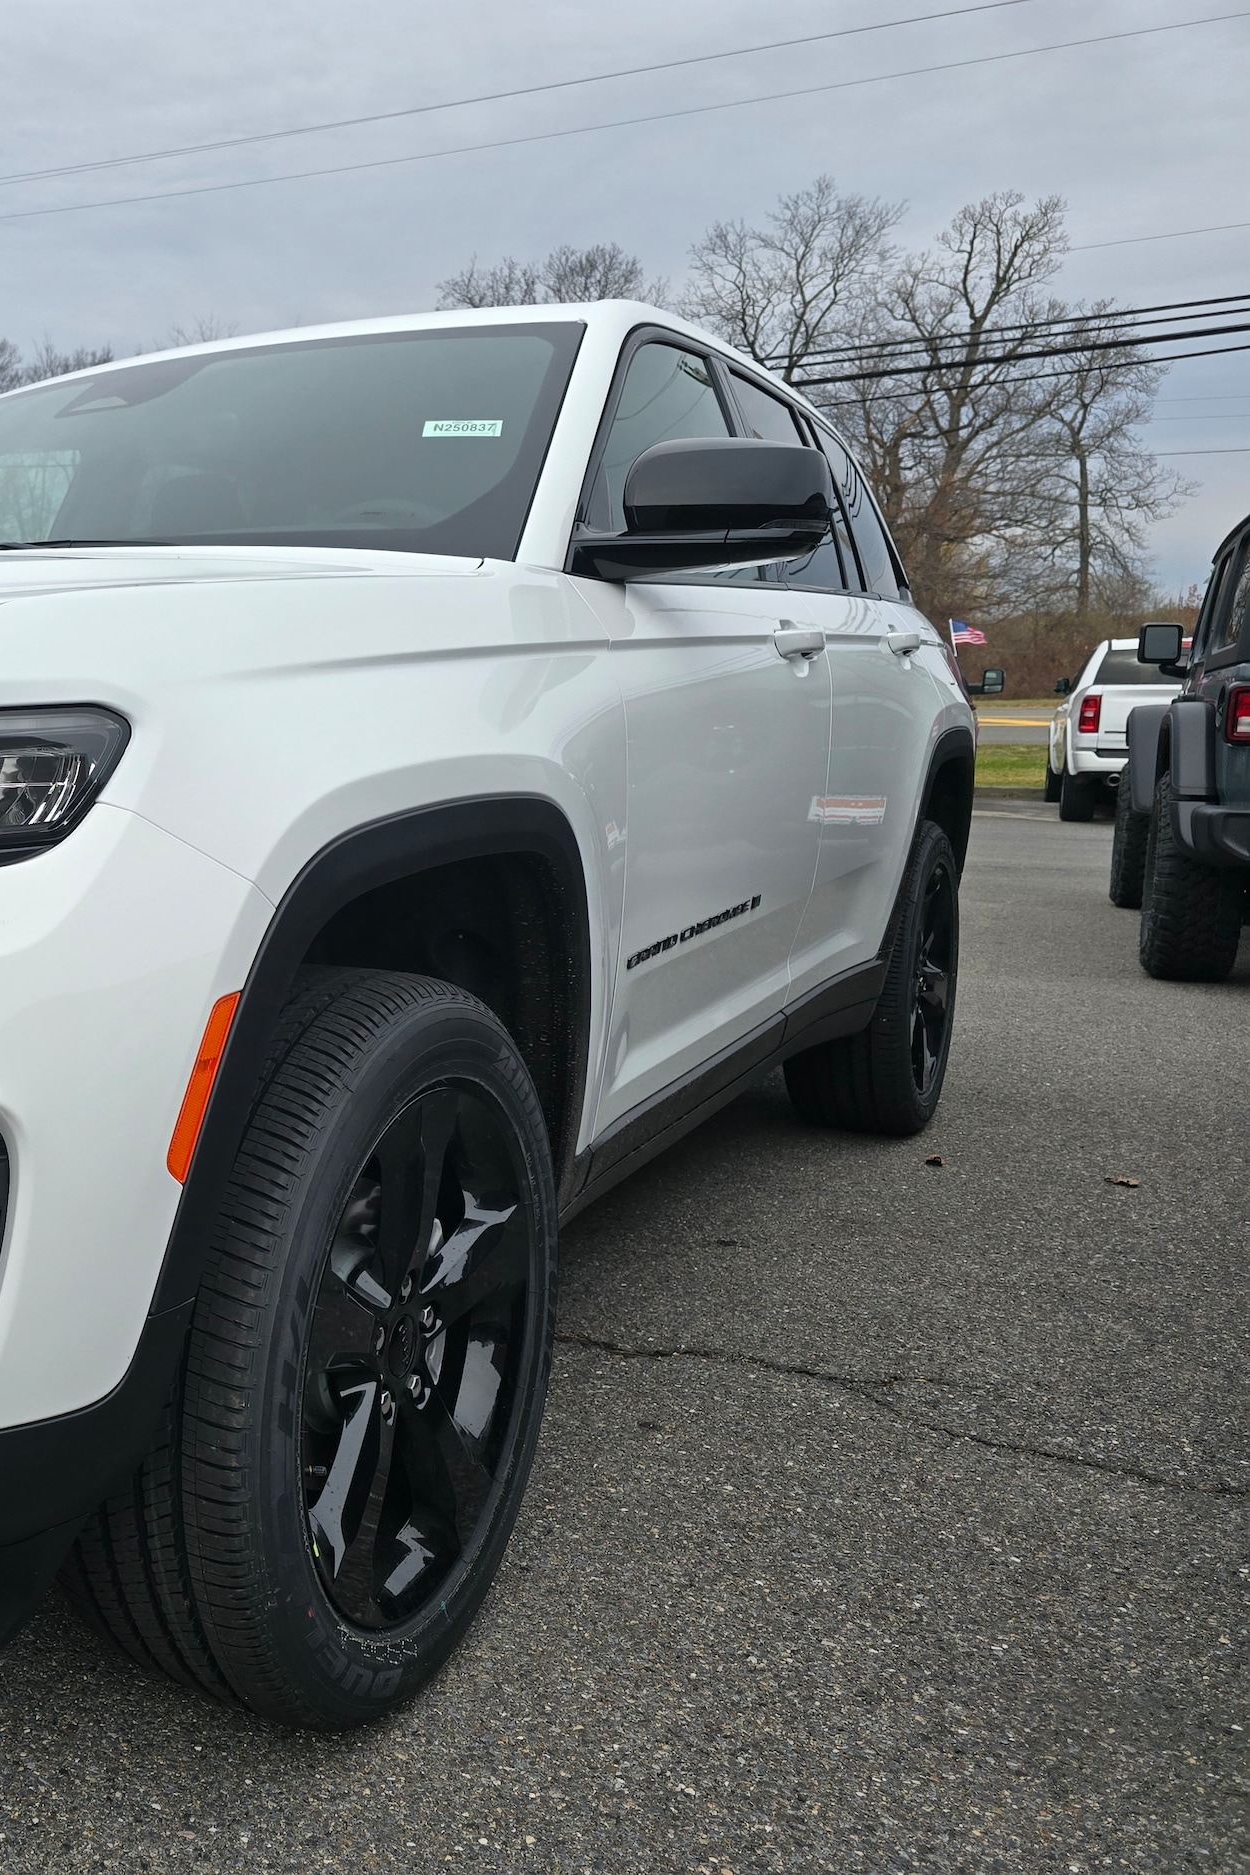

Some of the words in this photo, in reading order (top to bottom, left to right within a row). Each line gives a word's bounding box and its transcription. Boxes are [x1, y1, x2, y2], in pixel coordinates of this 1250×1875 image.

[432, 423, 497, 433] N250837
[626, 933, 679, 970] GRAND
[680, 899, 751, 943] CHEROKEE
